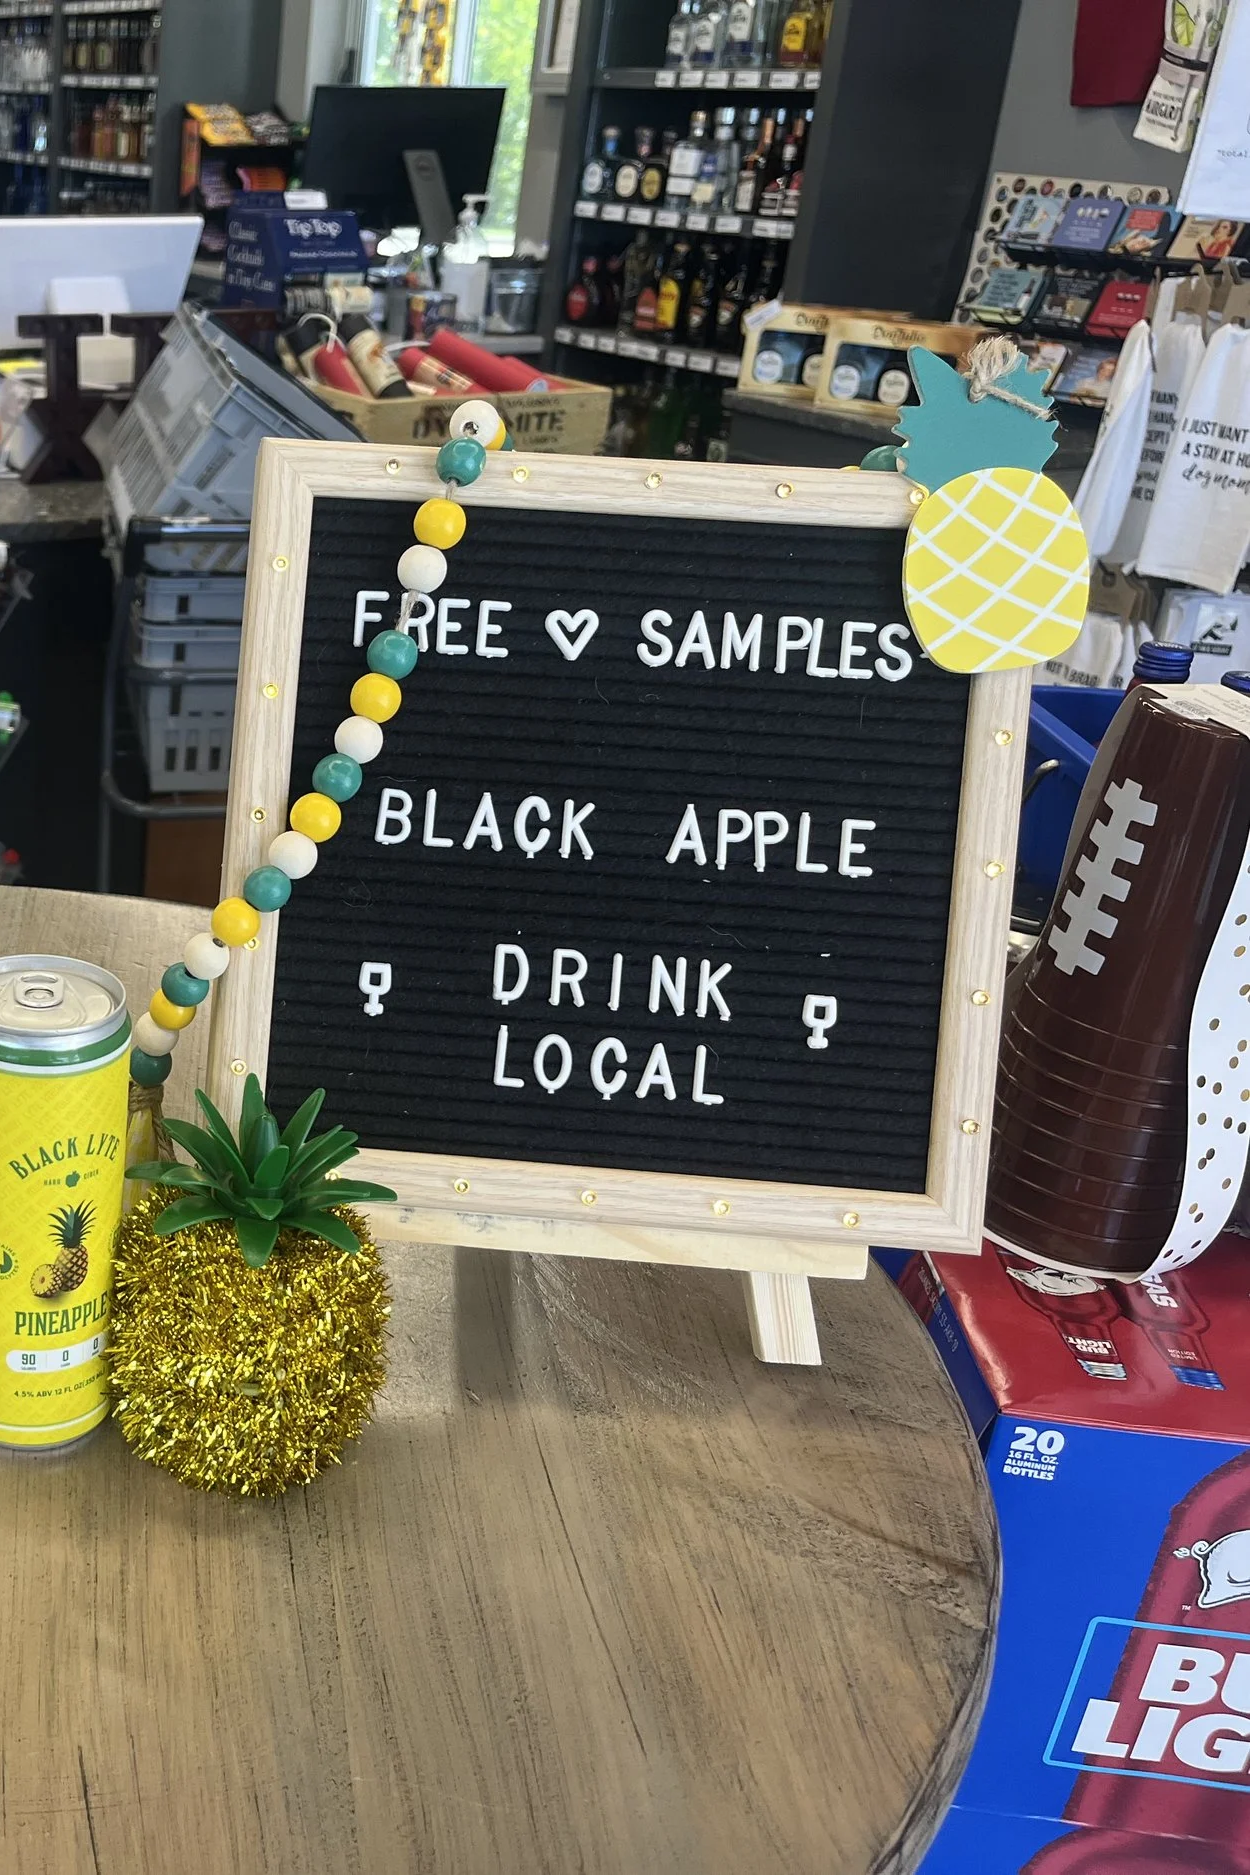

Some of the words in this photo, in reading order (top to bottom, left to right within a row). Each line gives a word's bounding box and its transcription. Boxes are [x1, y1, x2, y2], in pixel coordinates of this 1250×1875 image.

[352, 589, 513, 659] FREE
[636, 608, 914, 682] SAMPLES
[374, 787, 596, 860] BLACK
[665, 803, 877, 878] APPLE
[491, 942, 734, 1022] DRINK
[493, 1024, 726, 1106] LOCAL
[9, 1136, 79, 1180] BLACK
[86, 1132, 121, 1162] LYTE
[15, 1290, 108, 1337] PINEAPPLE
[1067, 1335, 1111, 1349] LIGHT
[1075, 1344, 1109, 1355] BUD
[21, 1353, 36, 1365] 90
[62, 1350, 69, 1362] 0
[55, 1388, 63, 1396] 12
[64, 1386, 73, 1394] FL
[1009, 1426, 1066, 1455] 20
[1005, 1458, 1056, 1472] ALUMINUM
[1008, 1450, 1023, 1460] 16
[1023, 1452, 1039, 1463] FL.
[1041, 1454, 1059, 1465] OZ.
[1003, 1465, 1054, 1481] BOTTLES
